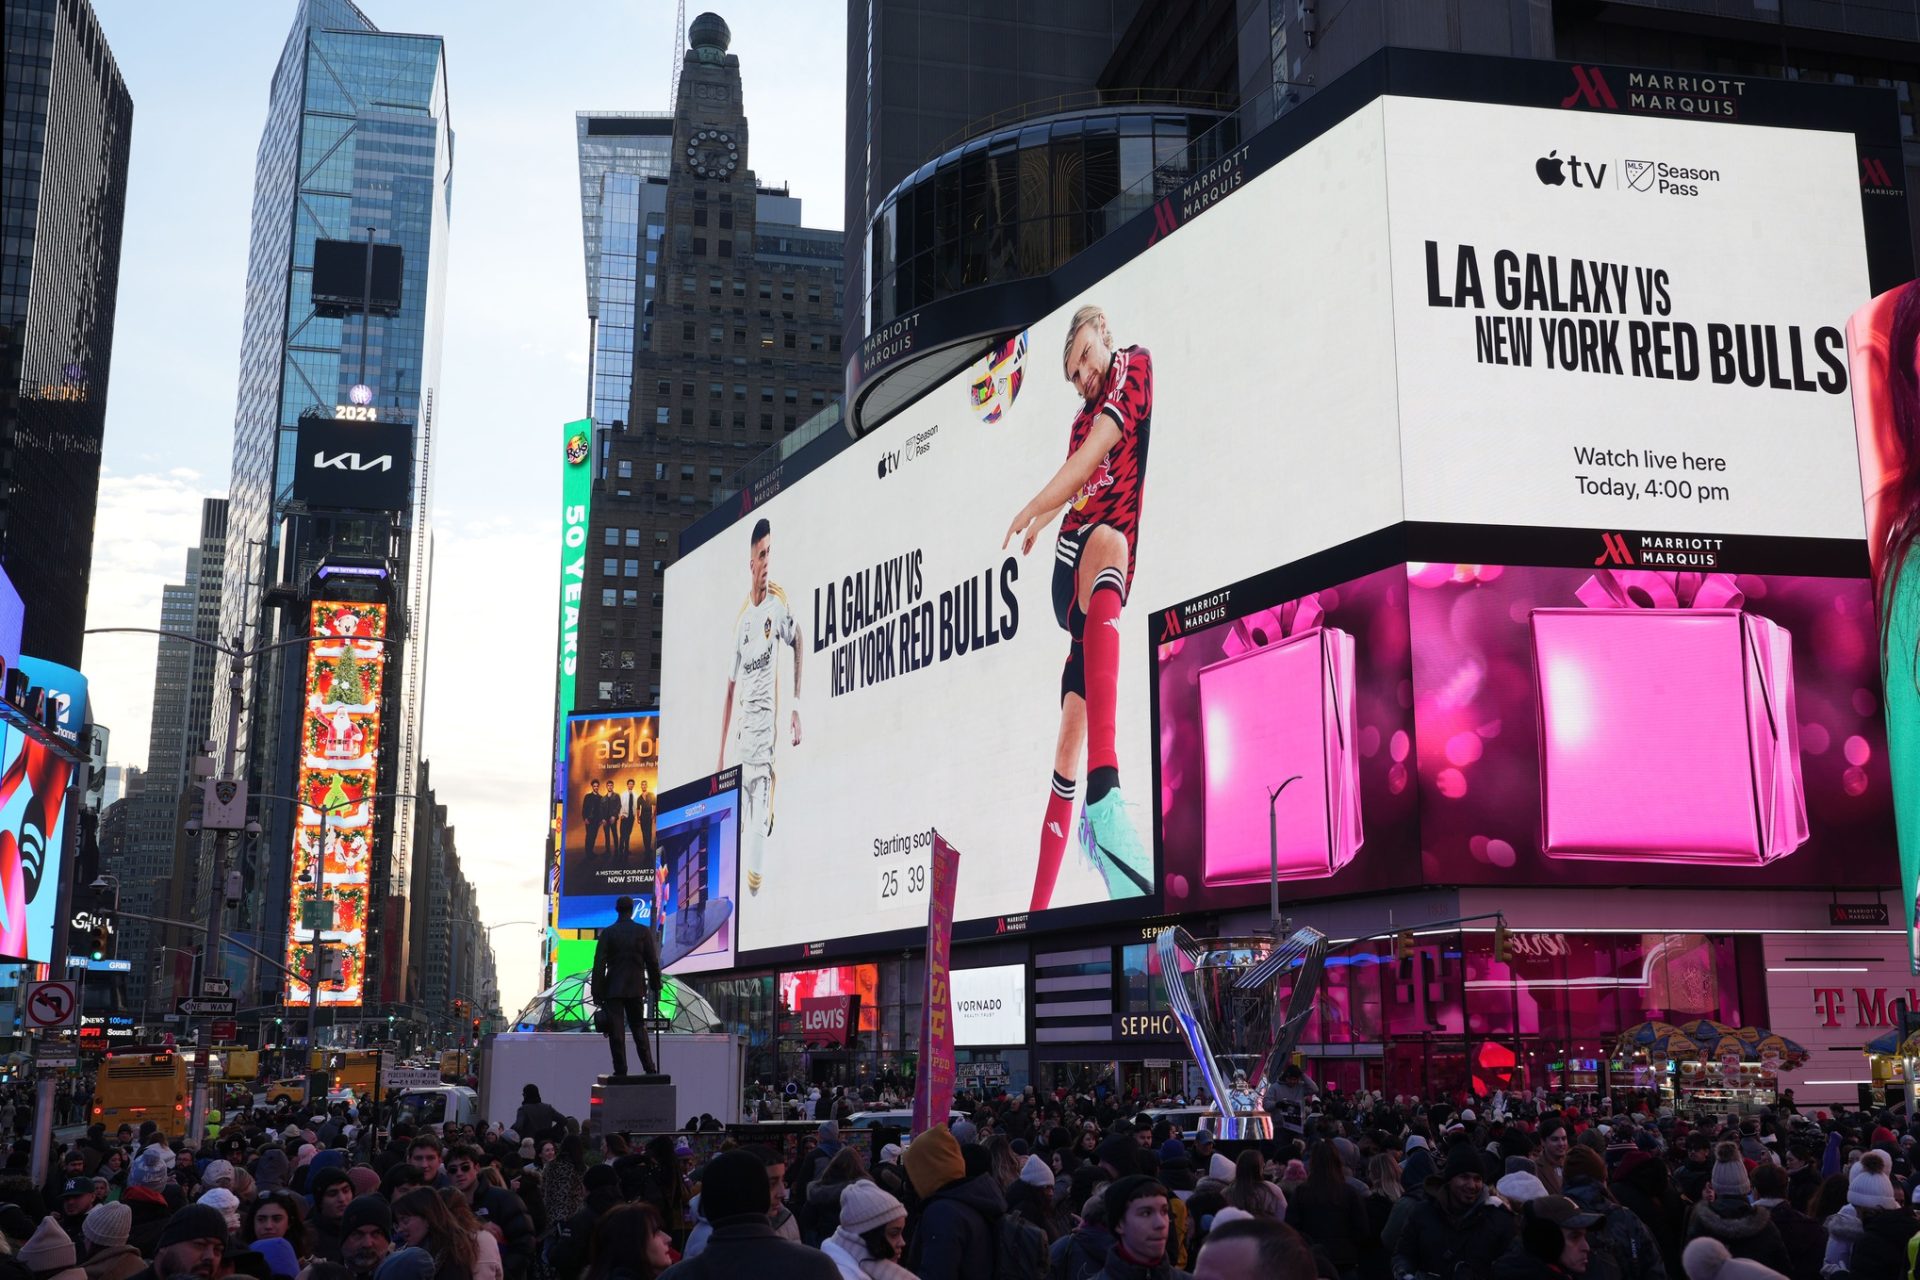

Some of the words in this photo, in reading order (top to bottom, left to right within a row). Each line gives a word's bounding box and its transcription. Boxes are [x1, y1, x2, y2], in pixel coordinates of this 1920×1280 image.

[1629, 72, 1746, 96] MARRIOTT
[1631, 93, 1735, 116] MARQUIS
[1182, 145, 1250, 201] MARRIOTT
[1567, 155, 1607, 190] tv
[1628, 162, 1644, 171] MLS
[1657, 162, 1721, 183] Season
[1183, 169, 1244, 221] MARQUIS
[1658, 179, 1699, 197] Pass
[1864, 187, 1904, 197] MARRIOTT
[1424, 239, 1486, 309] LA
[1493, 248, 1629, 315] GALAXY
[1634, 266, 1672, 317] VS
[862, 312, 921, 356] MARRIOTT
[862, 335, 913, 374] MARQUIS
[1475, 314, 1533, 368] NEW
[1539, 316, 1624, 376] YORK
[1628, 320, 1700, 382] RED
[1707, 322, 1848, 395] BULLS
[335, 406, 377, 421] 2024
[916, 424, 939, 445] Season
[887, 449, 901, 474] tv
[916, 442, 930, 457] Pass
[1573, 446, 1639, 468] Watch
[1644, 449, 1678, 470] live
[1682, 451, 1727, 472] here
[754, 465, 784, 492] MARRIOTT
[1575, 475, 1640, 500] Today,
[1644, 479, 1692, 499] 4:00
[1697, 484, 1730, 503] pm
[754, 480, 781, 506] MARQUIS
[566, 504, 585, 549] 50
[1641, 536, 1723, 551] MARRIOTT
[1642, 552, 1715, 565] MARQUIS
[813, 581, 838, 654] LA
[841, 555, 903, 638] GALAXY
[905, 548, 923, 605] VS
[1185, 590, 1231, 616] MARRIOTT
[564, 562, 585, 676] YEARS
[831, 639, 856, 698] NEW
[858, 617, 896, 689] YORK
[899, 600, 934, 676] RED
[939, 556, 1019, 663] BULLS
[1185, 606, 1226, 629] MARQUIS
[718, 768, 738, 782] MARRIOTT
[718, 778, 736, 791] MARQUIS
[873, 833, 912, 857] Starting
[913, 831, 932, 850] soo
[882, 869, 898, 899] 25
[907, 864, 925, 894] 39
[1007, 914, 1029, 924] MARRIOTT
[1007, 921, 1027, 931] MARQUIS
[185, 1002, 201, 1011] ONE
[210, 1003, 229, 1011] WAY
[957, 999, 1002, 1012] VORNADO
[1121, 1015, 1180, 1036] SEPHO
